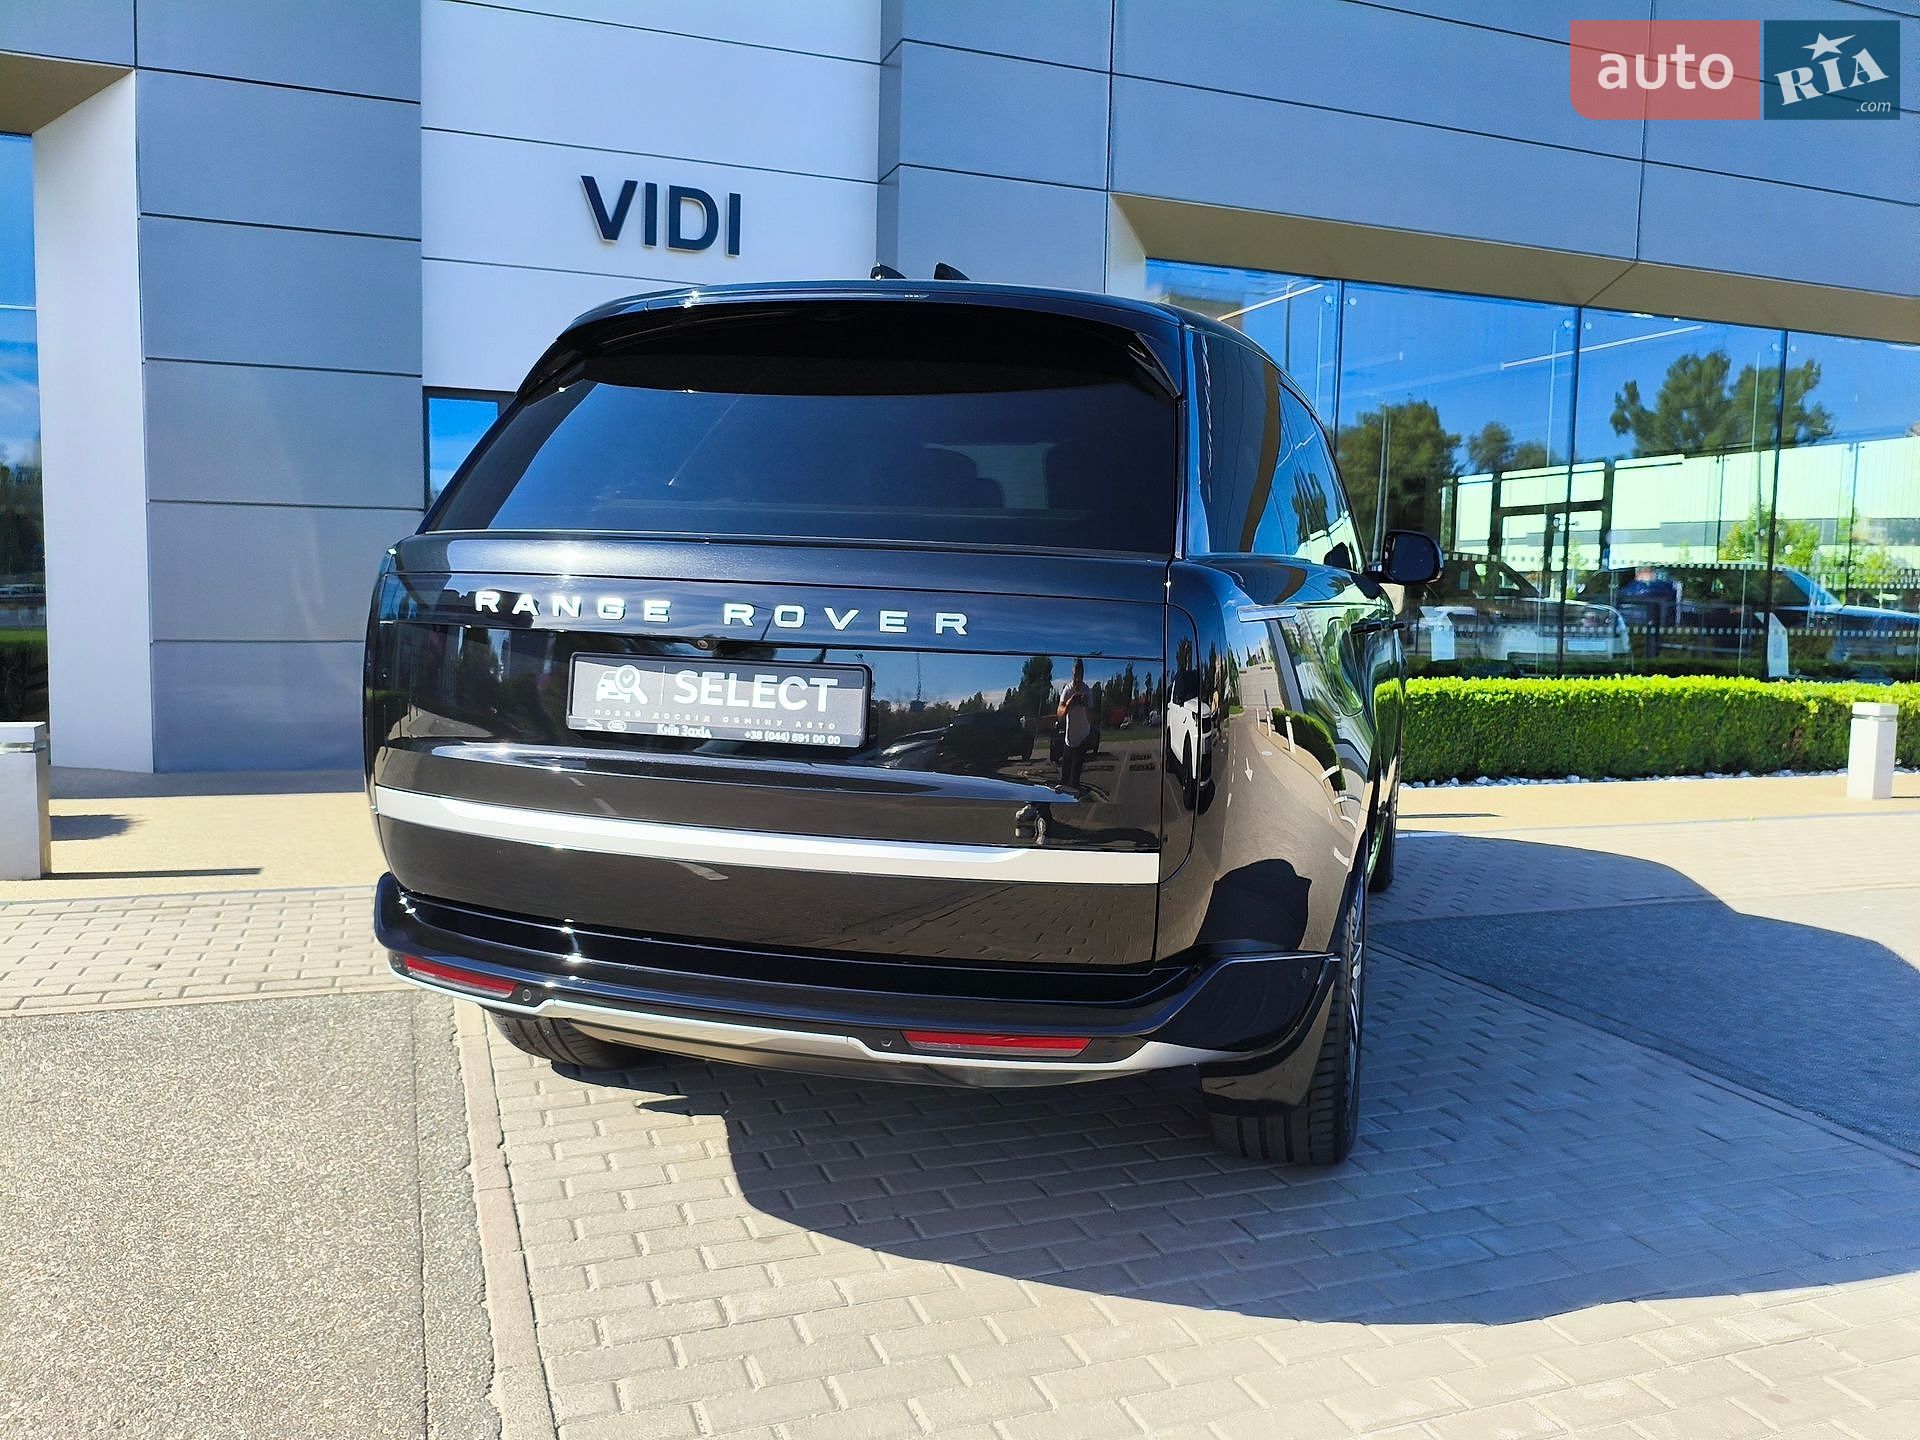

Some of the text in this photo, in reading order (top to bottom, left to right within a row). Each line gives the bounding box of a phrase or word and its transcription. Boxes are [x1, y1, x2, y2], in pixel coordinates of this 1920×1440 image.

[580, 175, 742, 256] VIDI
[474, 590, 969, 635] RANGE ROVER
[673, 669, 839, 712] SELECT
[744, 730, 841, 745] +38 (044) 591 00 00
[795, 721, 836, 730] АВТО
